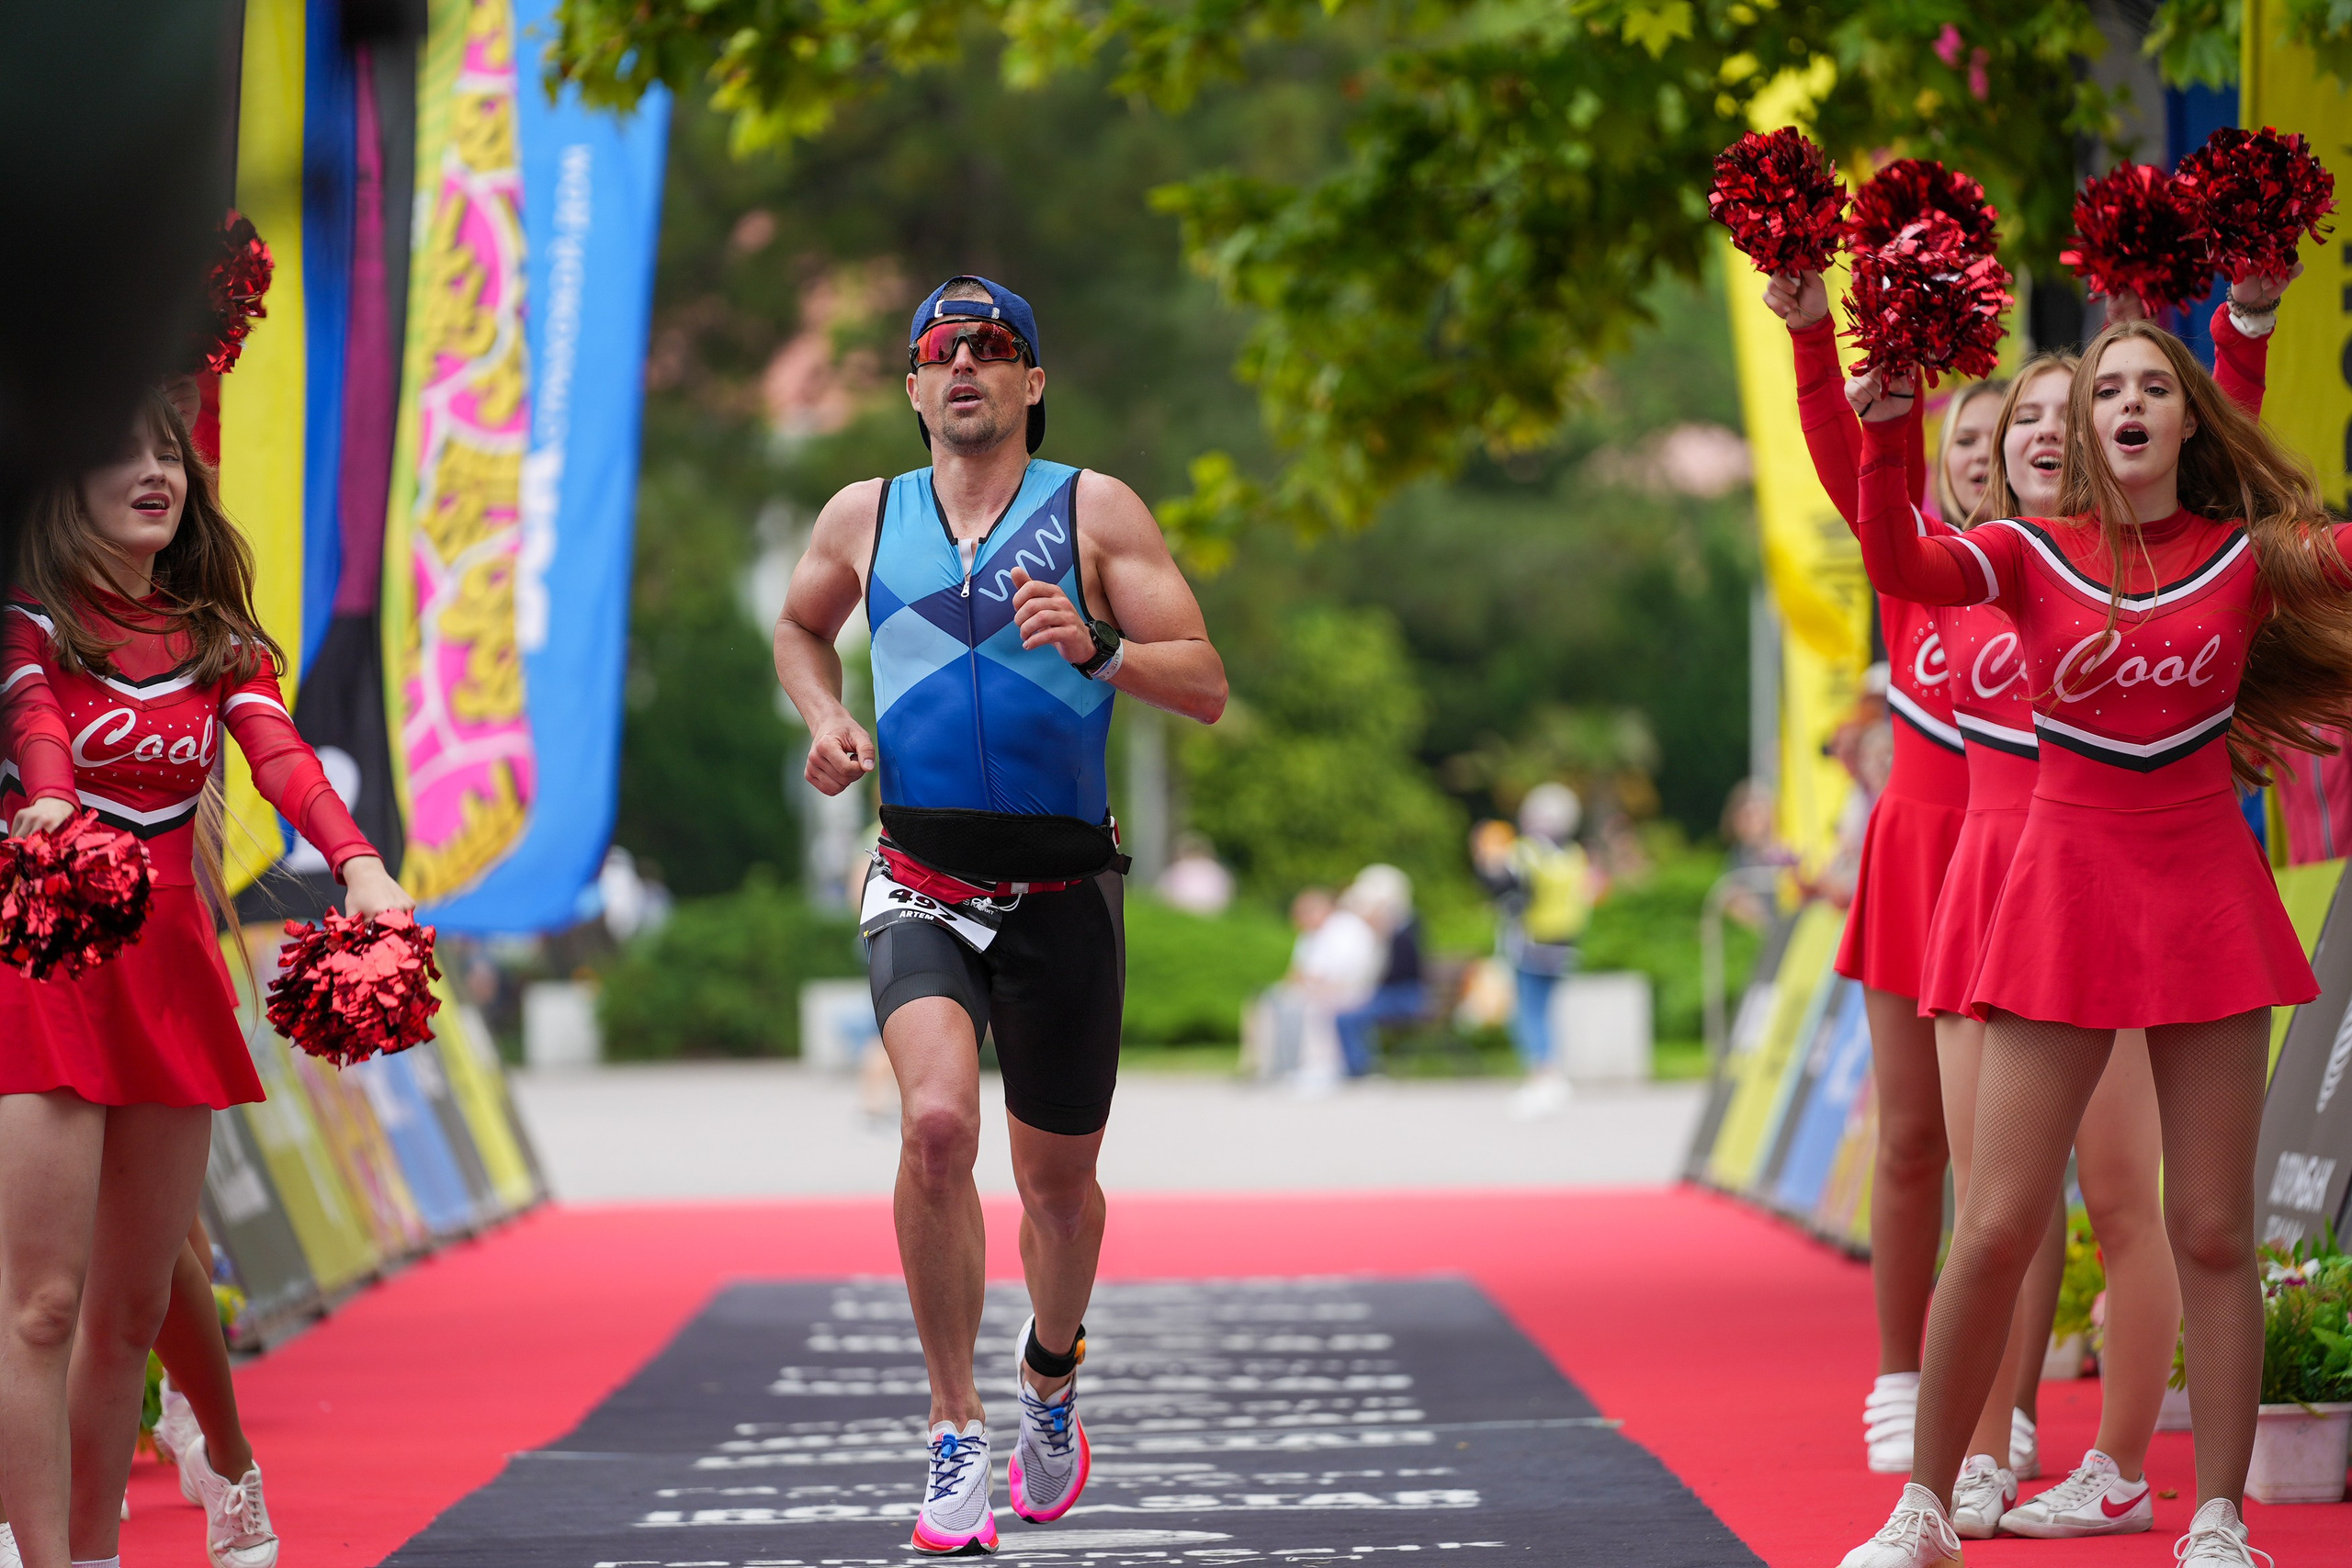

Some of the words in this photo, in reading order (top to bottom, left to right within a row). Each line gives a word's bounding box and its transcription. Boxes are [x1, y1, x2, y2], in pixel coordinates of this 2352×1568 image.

[2052, 629, 2221, 704] Cool
[71, 707, 218, 768] Cool
[899, 909, 935, 921] ARTEM
[1138, 1488, 1482, 1508] STAR
